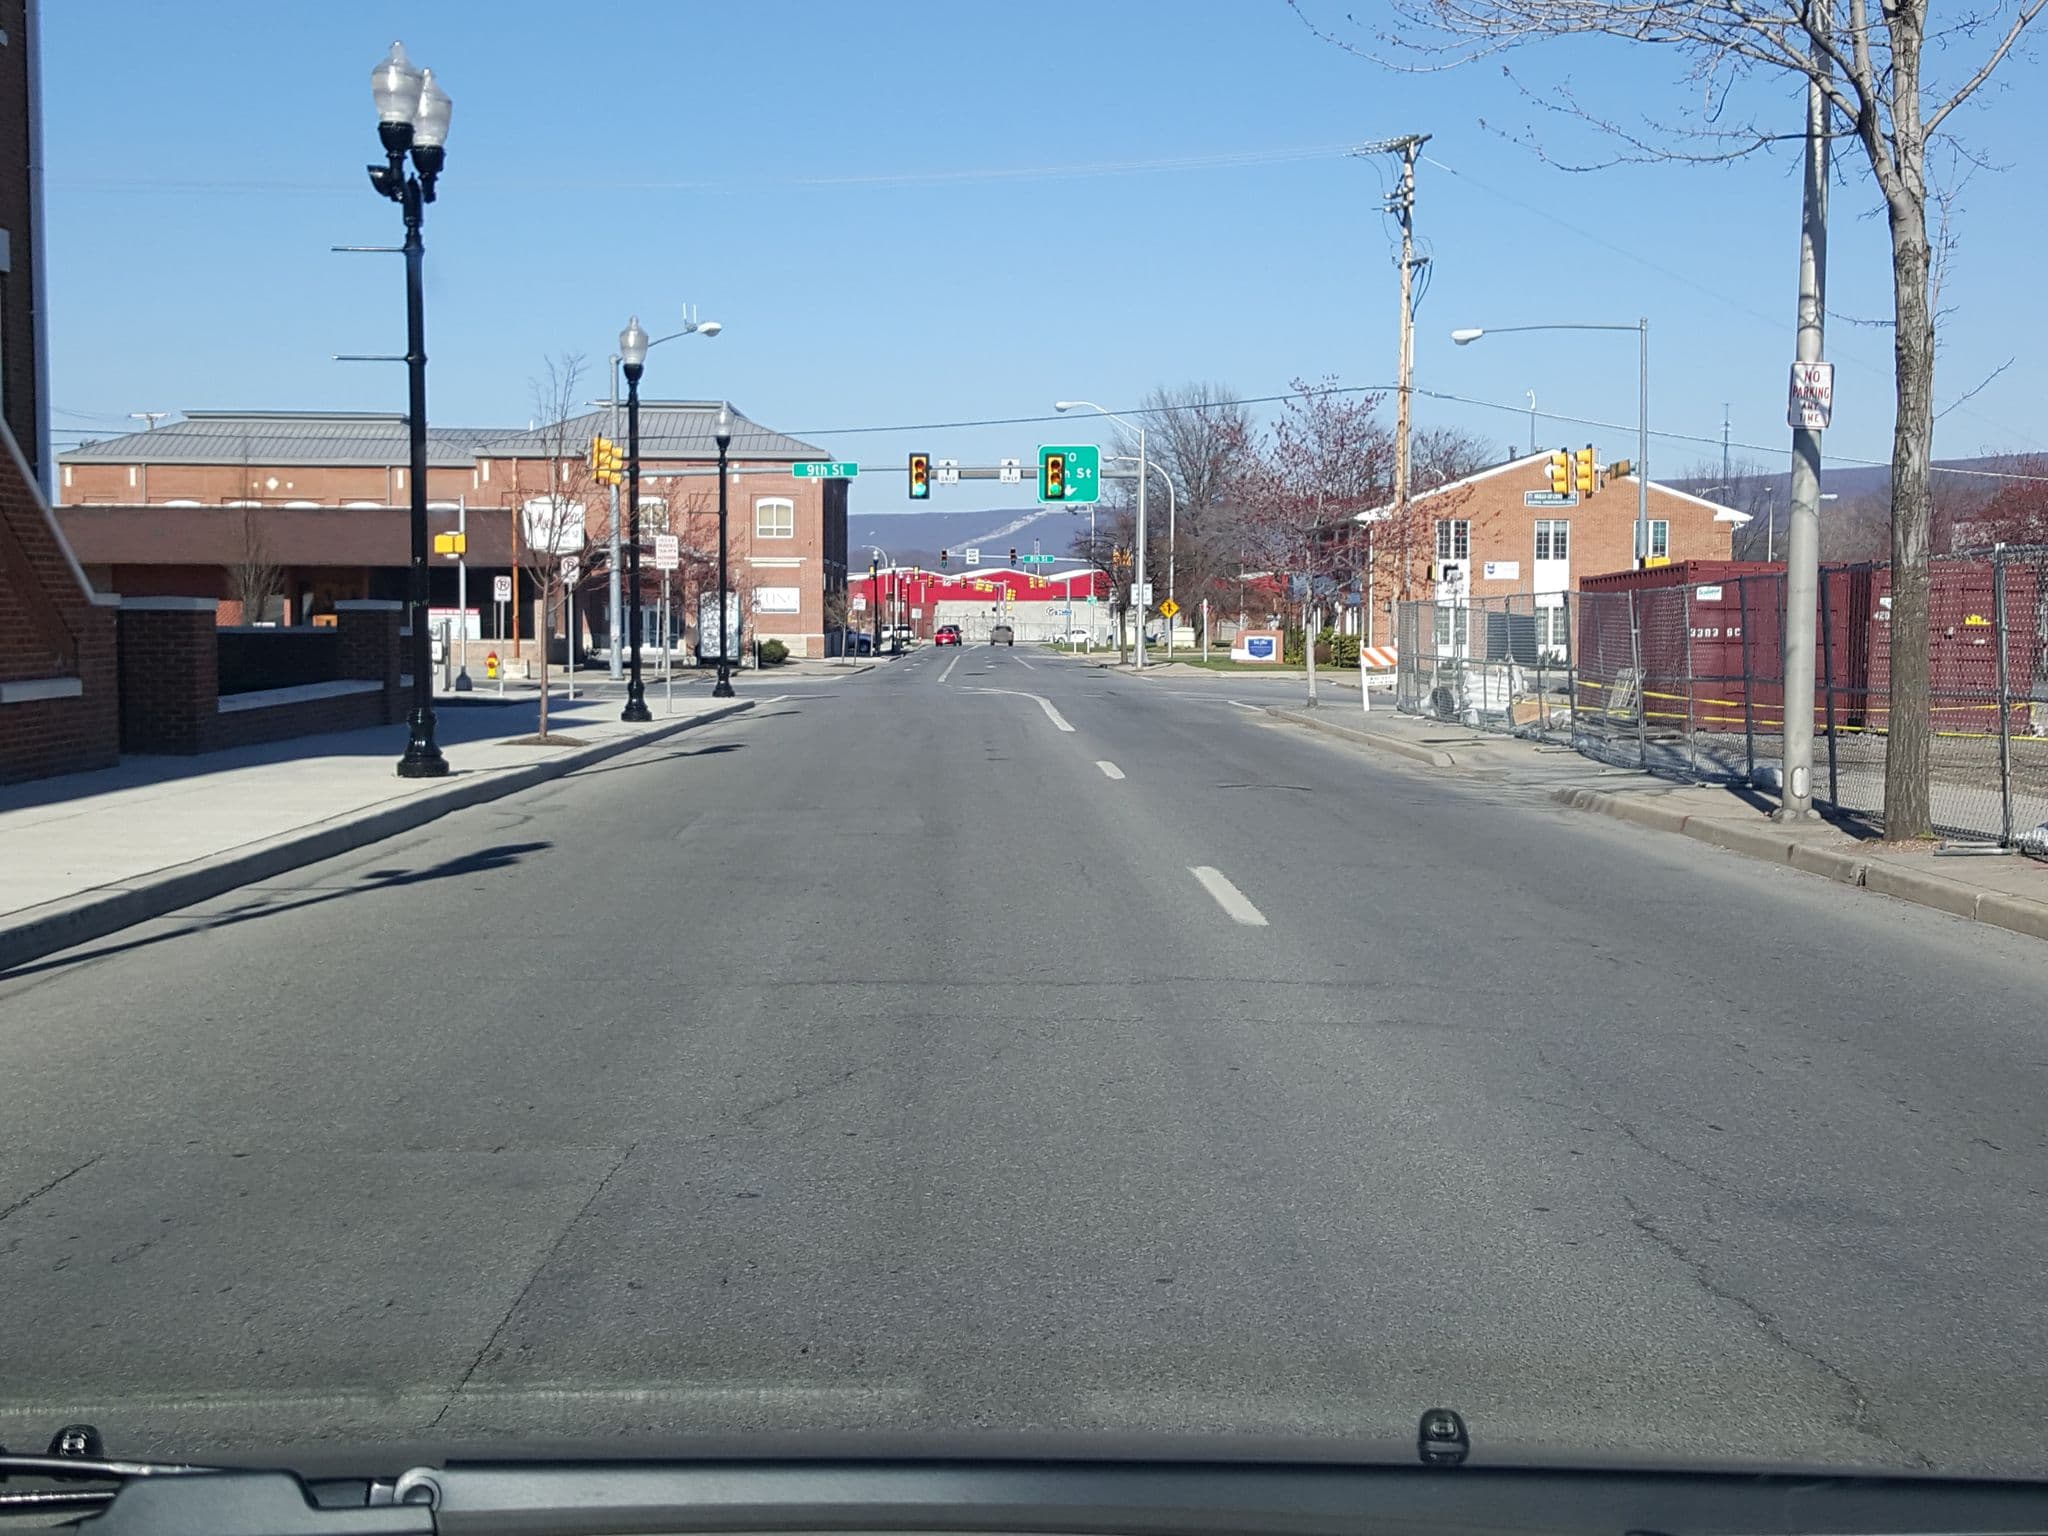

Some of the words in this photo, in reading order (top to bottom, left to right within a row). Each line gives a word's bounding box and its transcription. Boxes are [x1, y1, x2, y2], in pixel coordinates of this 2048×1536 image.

[1804, 369, 1821, 383] NO
[1792, 384, 1830, 399] PARKING
[1801, 401, 1819, 410] ANY
[1799, 412, 1819, 422] TIME
[806, 463, 828, 477] 9th
[831, 463, 845, 477] St
[1076, 467, 1092, 479] St
